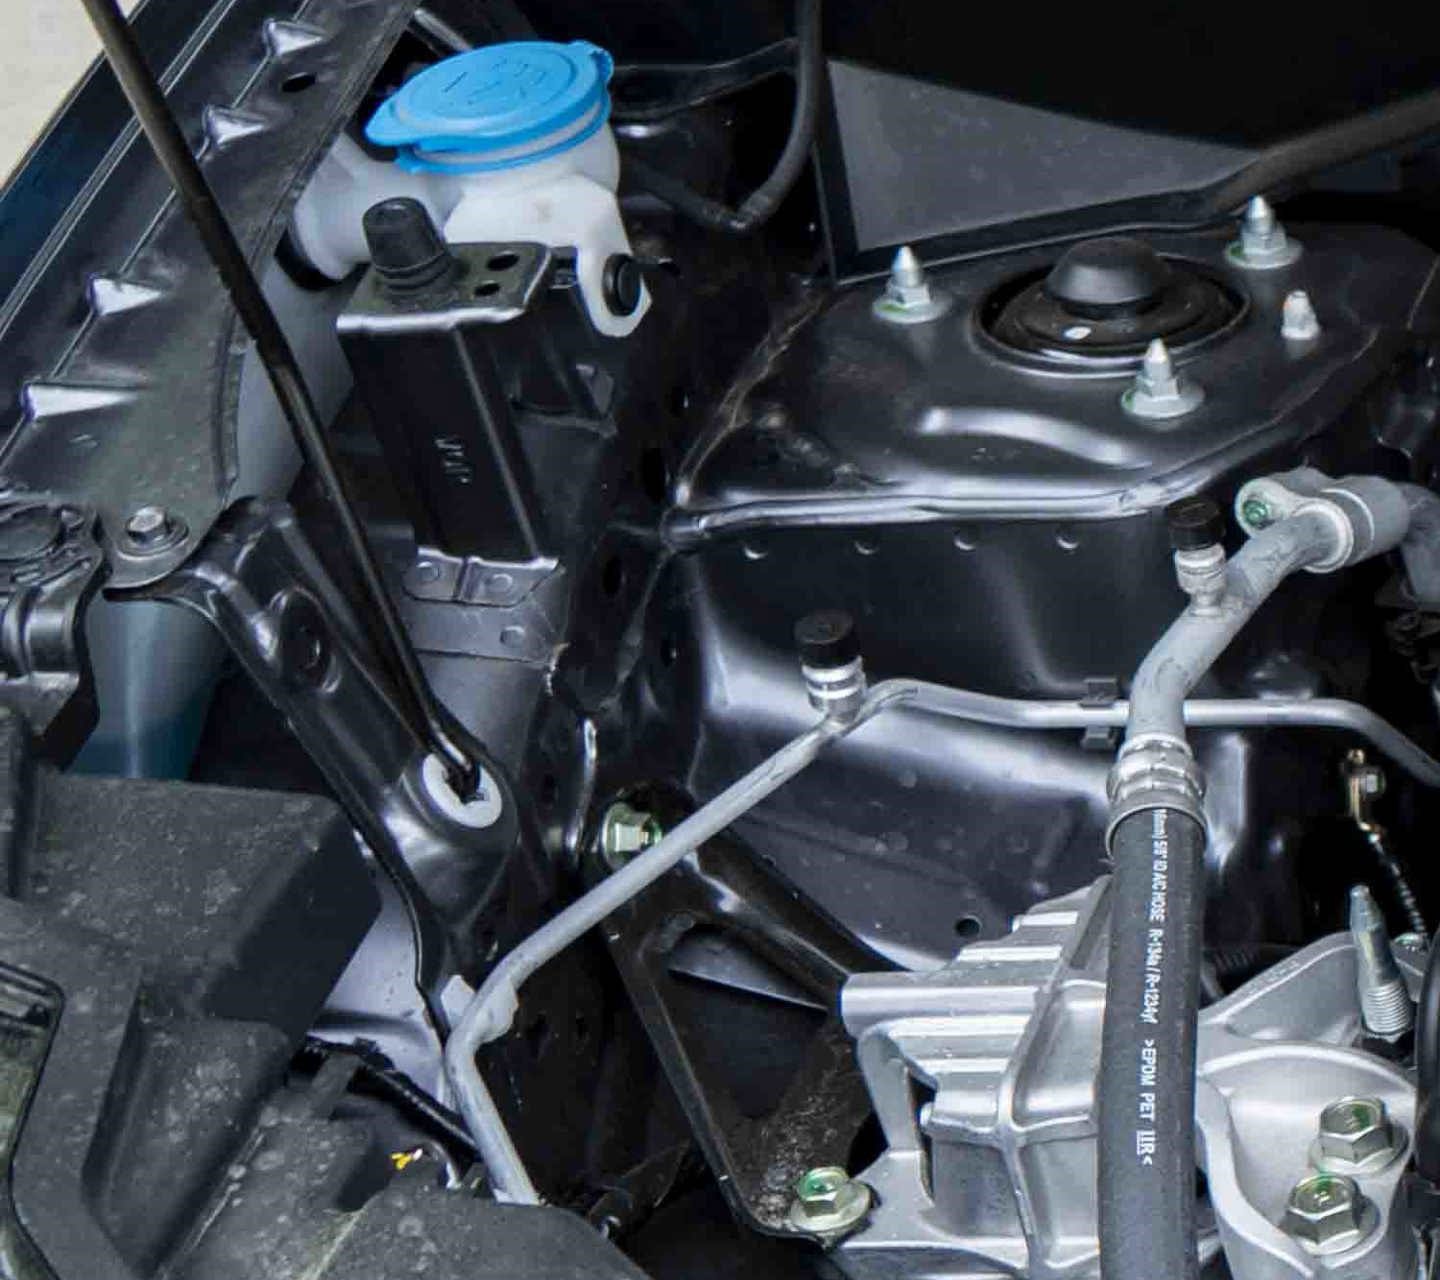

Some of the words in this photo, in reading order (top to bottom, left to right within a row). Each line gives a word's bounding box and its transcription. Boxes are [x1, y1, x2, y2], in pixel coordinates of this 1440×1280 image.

[1151, 872, 1166, 891] A/C
[1149, 891, 1165, 921] HOSE
[1146, 928, 1163, 966] R-134a
[1140, 973, 1161, 1024] R-1234yf
[1139, 1093, 1156, 1122] PET
